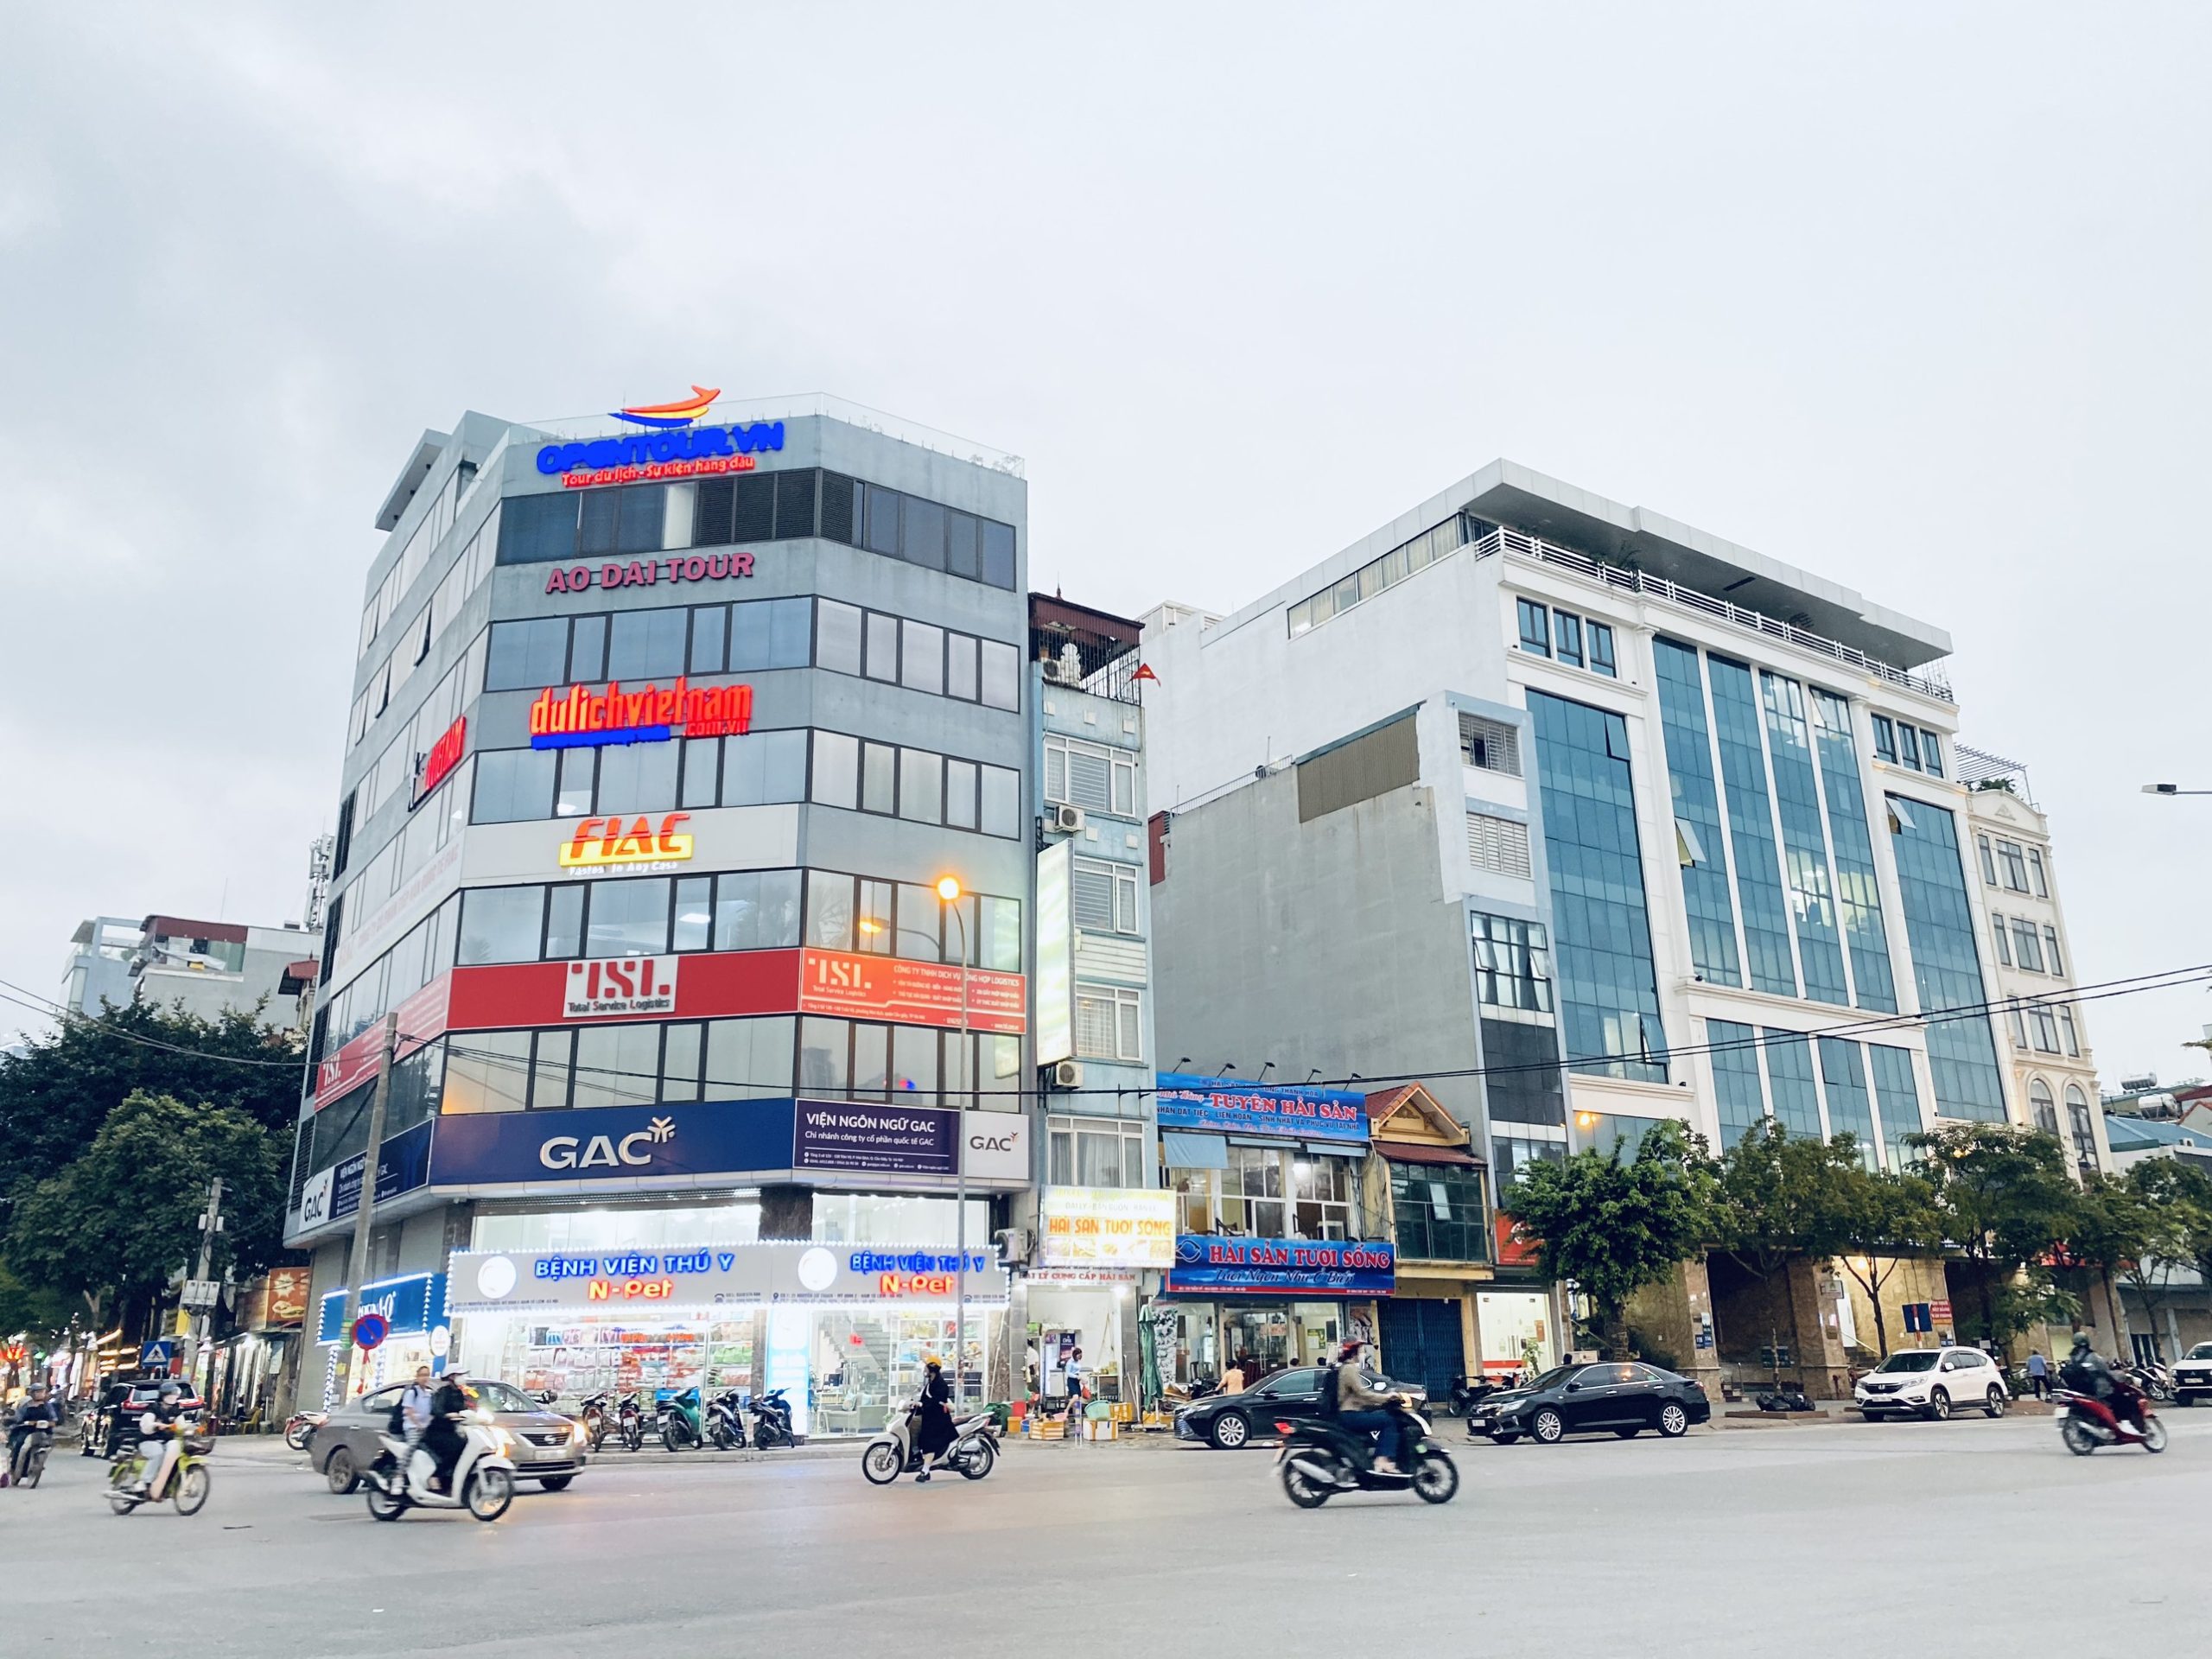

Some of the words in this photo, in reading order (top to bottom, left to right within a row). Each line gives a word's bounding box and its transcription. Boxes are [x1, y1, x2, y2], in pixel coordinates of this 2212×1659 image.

[563, 474, 591, 486] Tour
[545, 565, 591, 594] AO
[601, 560, 657, 588] DAI
[666, 552, 754, 582] TOUR
[530, 675, 752, 734] dulichvietnam
[570, 813, 690, 859] FIAC
[568, 1001, 590, 1012] Total
[593, 1000, 626, 1011] Service
[630, 998, 671, 1010] Logistics
[1209, 1092, 1277, 1113] TUYÊN
[1281, 1096, 1315, 1116] HẢI
[1319, 1100, 1357, 1121] SẢN
[806, 1112, 836, 1128] VIỆN
[839, 1115, 876, 1129] NGÔN
[880, 1117, 908, 1131] NGỮ
[910, 1121, 936, 1133] GAC
[540, 1130, 652, 1170] GAC
[858, 1134, 866, 1143] ty
[918, 1137, 934, 1147] GAC
[969, 1135, 1012, 1152] GAC
[304, 1191, 324, 1224] GAC
[535, 1255, 597, 1281] BỆNH
[604, 1252, 657, 1280] VIỆN
[664, 1248, 709, 1272] THÚ
[718, 1253, 734, 1271] Y
[850, 1251, 895, 1274] BỆNH
[898, 1250, 935, 1275] VIỆN
[973, 1255, 985, 1273] Y
[1209, 1239, 1244, 1264] HẢI
[1250, 1241, 1288, 1265] SẢN
[1294, 1248, 1338, 1267] TƯƠI
[1342, 1243, 1390, 1268] SỐNG
